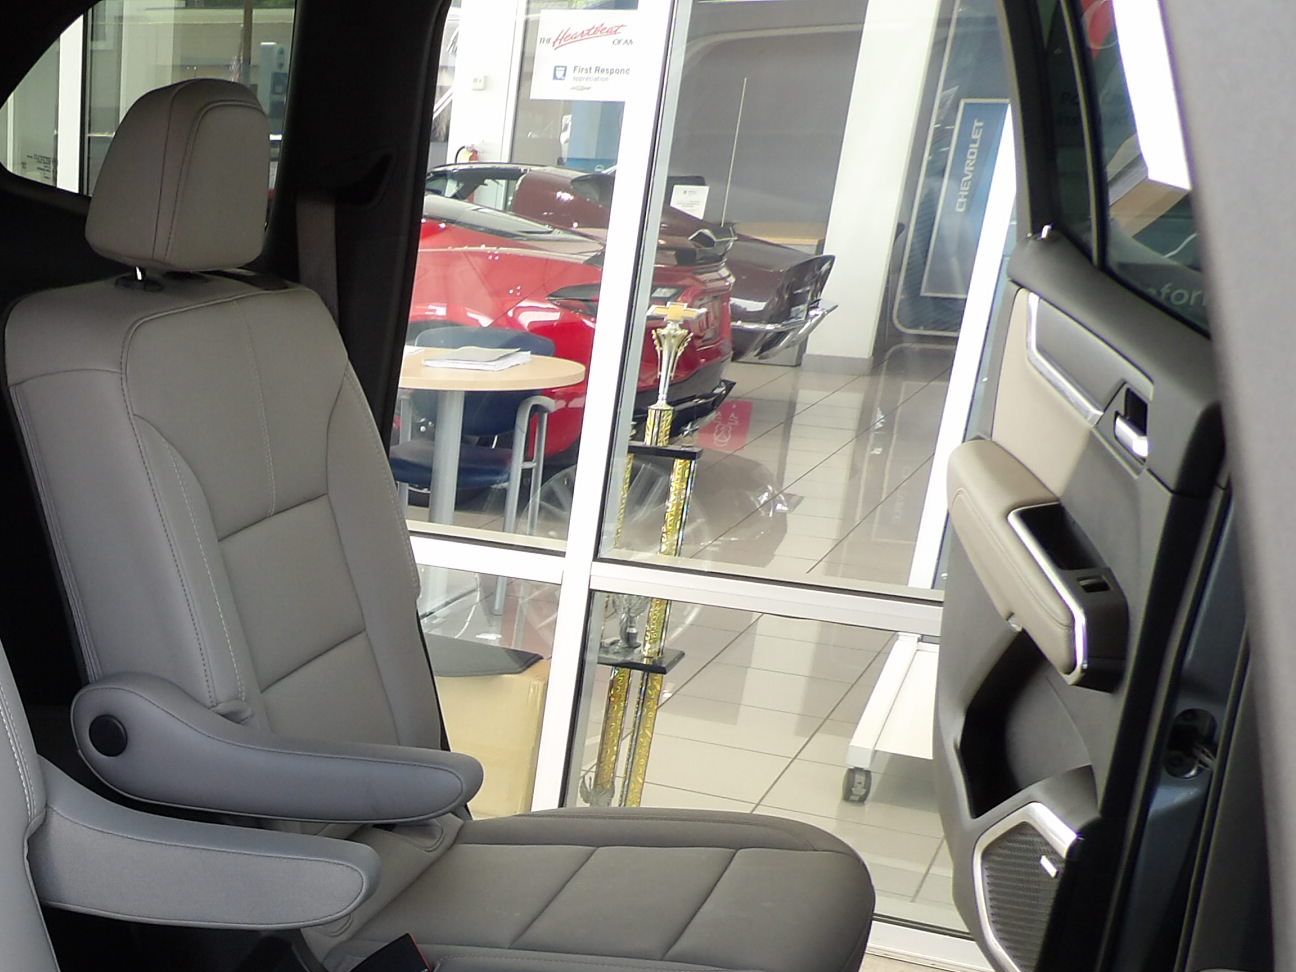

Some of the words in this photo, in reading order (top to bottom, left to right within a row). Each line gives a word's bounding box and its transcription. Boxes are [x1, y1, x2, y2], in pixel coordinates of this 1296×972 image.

[552, 23, 627, 49] Heartbeat
[573, 65, 592, 74] First
[956, 118, 984, 212] CHEVROLET
